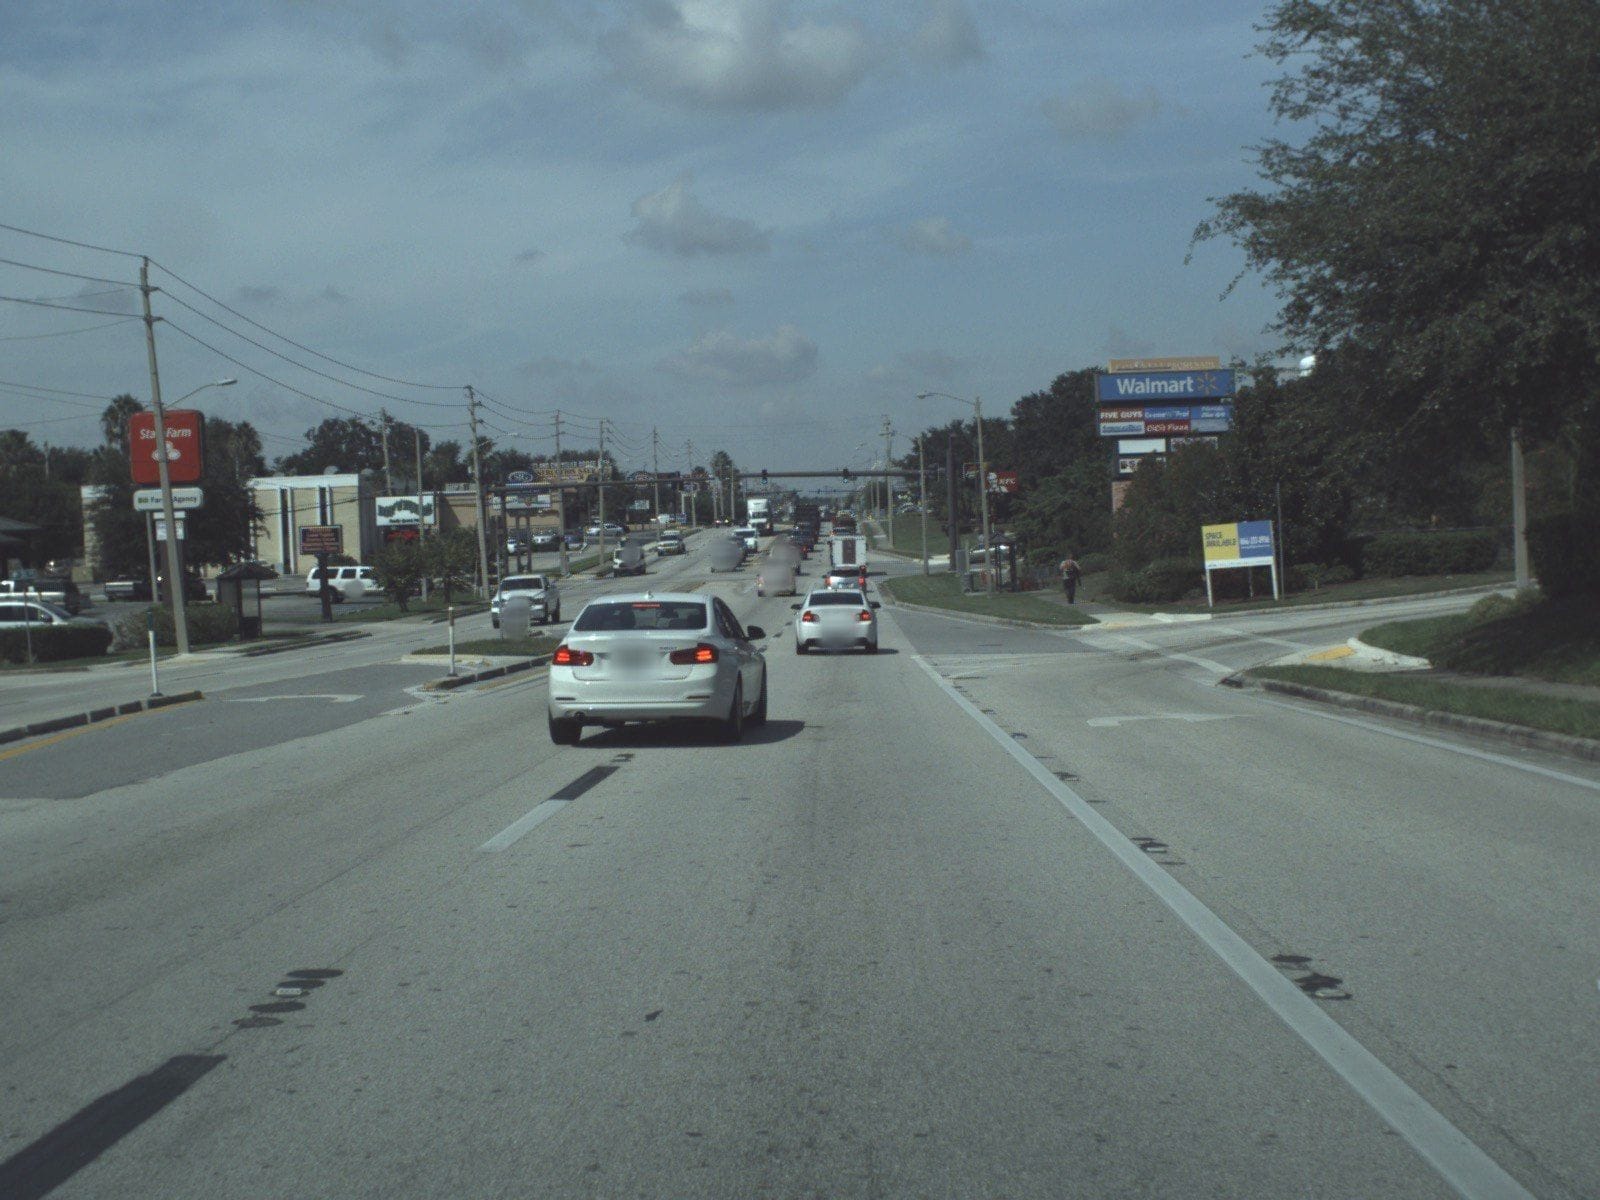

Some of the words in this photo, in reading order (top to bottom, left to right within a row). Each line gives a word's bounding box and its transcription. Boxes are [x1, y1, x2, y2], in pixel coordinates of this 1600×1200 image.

[1116, 376, 1194, 395] Walmart
[1100, 411, 1119, 419] FIVE
[1120, 410, 1143, 419] GUYS
[166, 427, 192, 438] Farm
